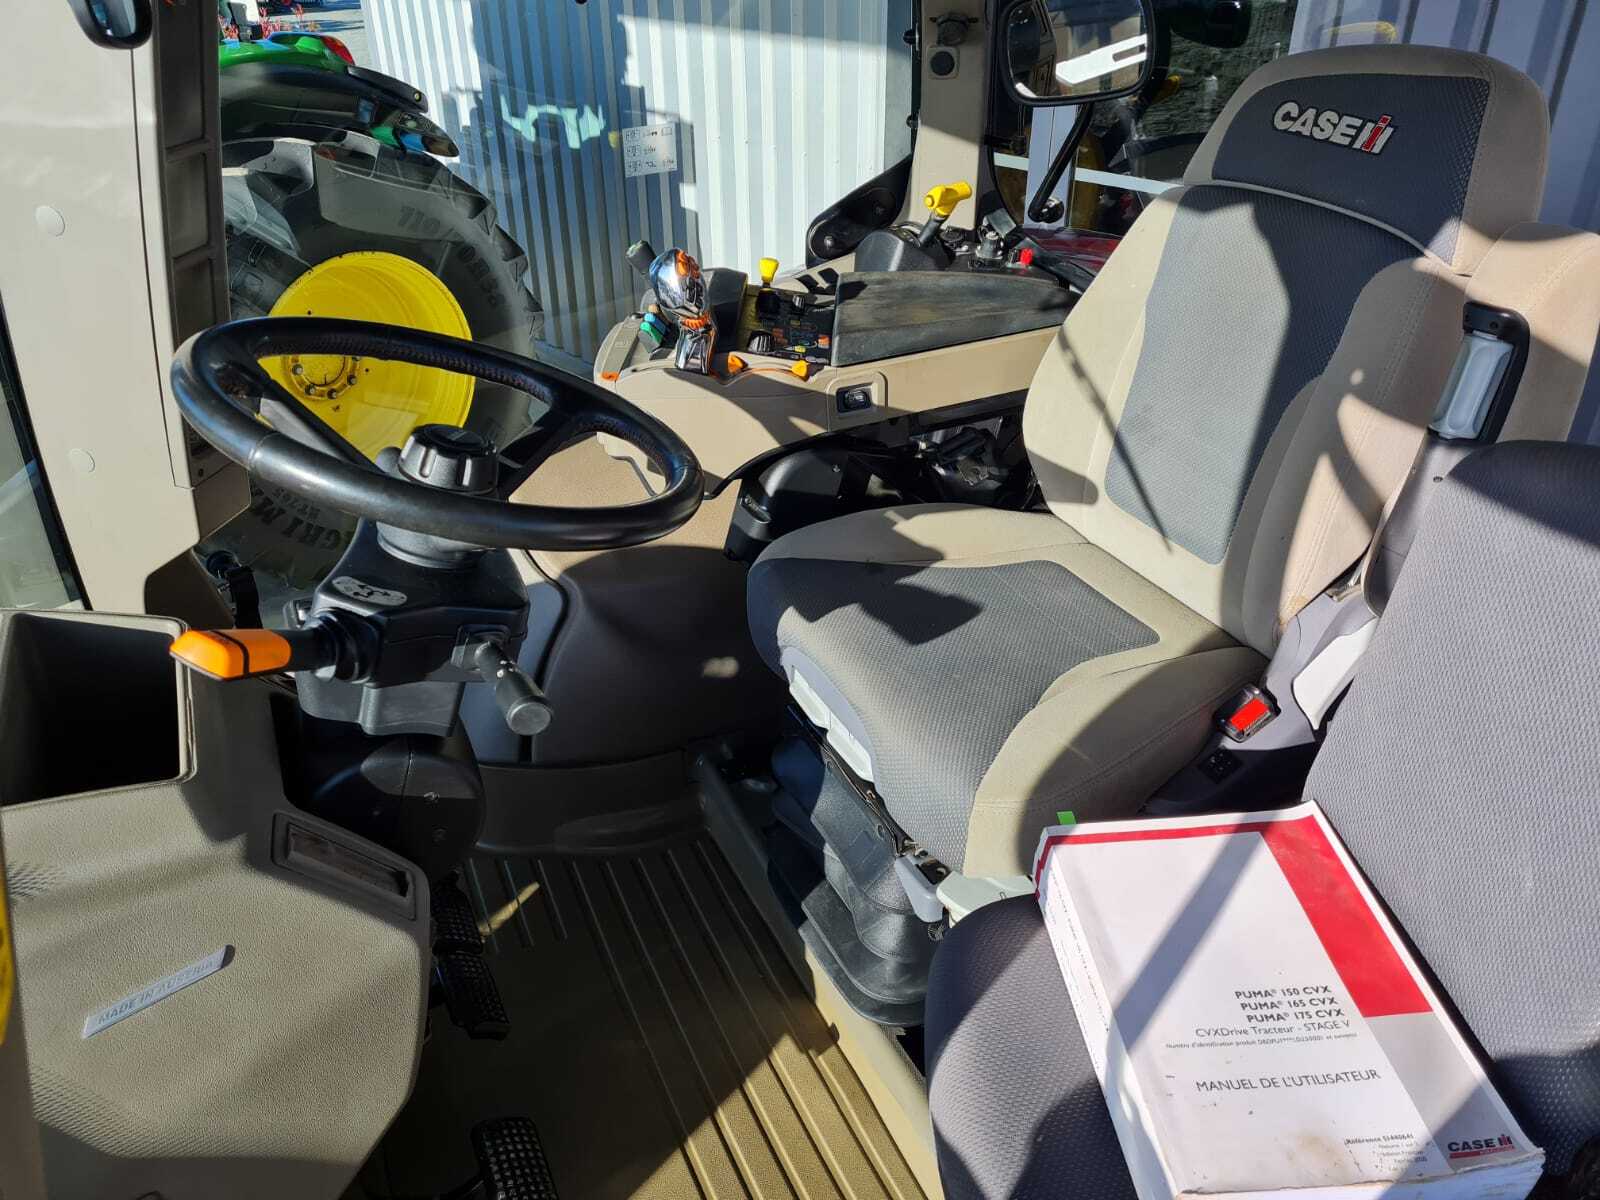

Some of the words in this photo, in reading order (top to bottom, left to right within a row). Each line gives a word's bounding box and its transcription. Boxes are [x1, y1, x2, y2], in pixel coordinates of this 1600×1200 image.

[1273, 101, 1363, 145] CASE
[1281, 987, 1300, 997] 150
[1302, 985, 1331, 995] CVX
[1287, 999, 1306, 1009] 165
[1309, 996, 1338, 1006] CVX
[1294, 1011, 1313, 1020] 175
[1315, 1008, 1345, 1018] CVX
[1195, 1027, 1248, 1038] CVXDrive
[1250, 1025, 1295, 1036] Tracteur
[1304, 1020, 1340, 1032] STAGE
[1196, 1079, 1258, 1092] MANUEL
[1259, 1077, 1280, 1089] DE
[1282, 1069, 1381, 1087] L'UTILISATEUR
[1448, 1138, 1496, 1152] CASE
